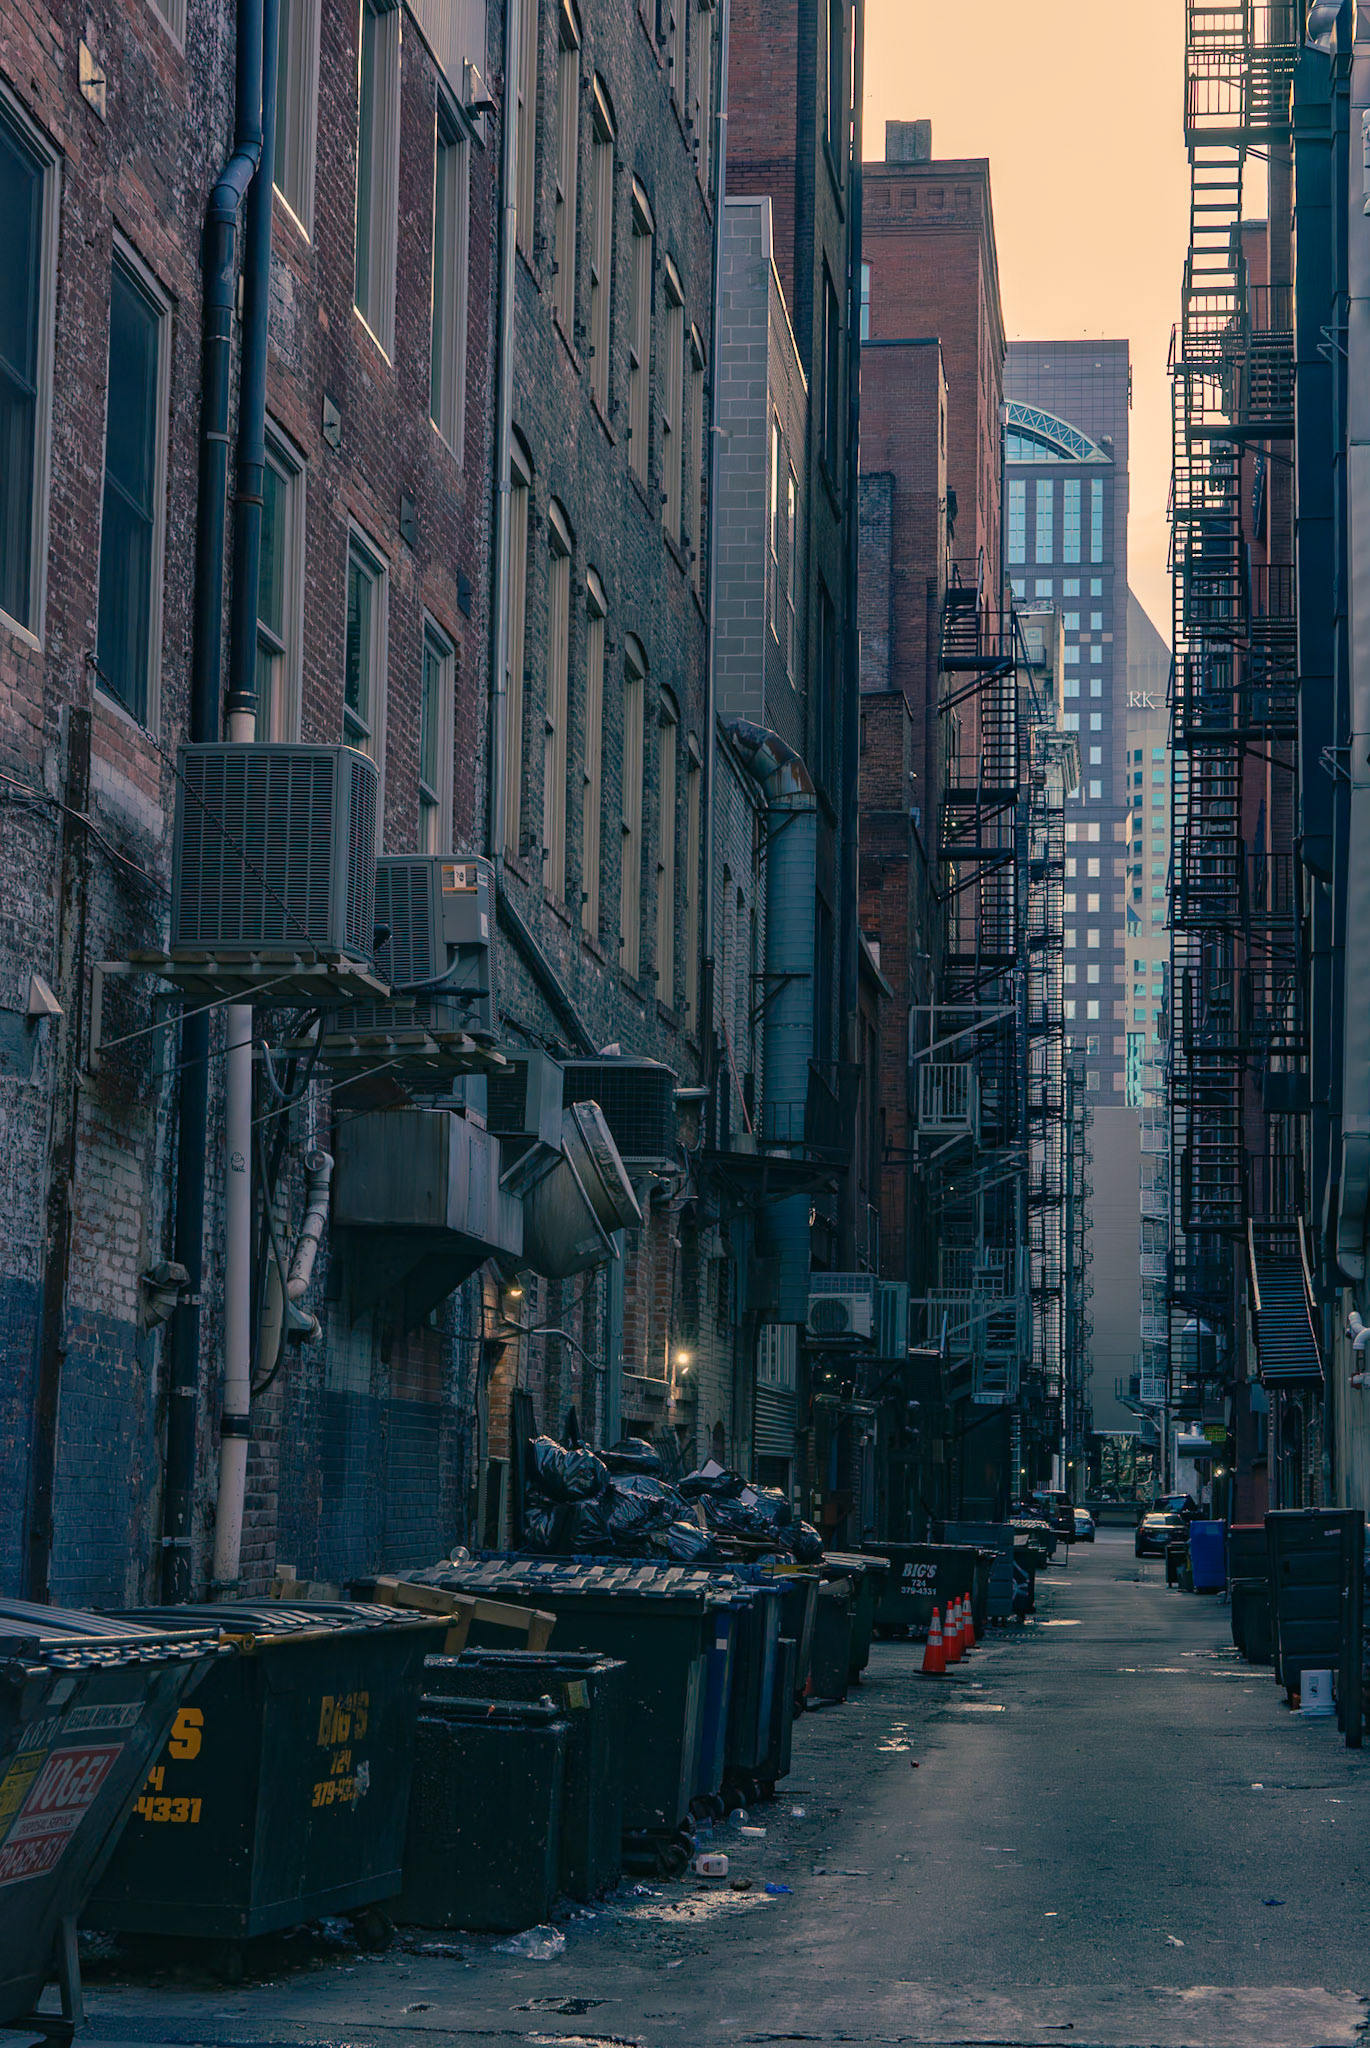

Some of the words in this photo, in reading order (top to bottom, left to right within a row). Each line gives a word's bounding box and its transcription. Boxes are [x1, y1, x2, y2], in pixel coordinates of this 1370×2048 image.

[1126, 691, 1156, 710] RK
[902, 1562, 937, 1578] BIG'S
[911, 1579, 927, 1588] 724
[330, 1749, 352, 1775] 724
[28, 1755, 111, 1813] VOGEL
